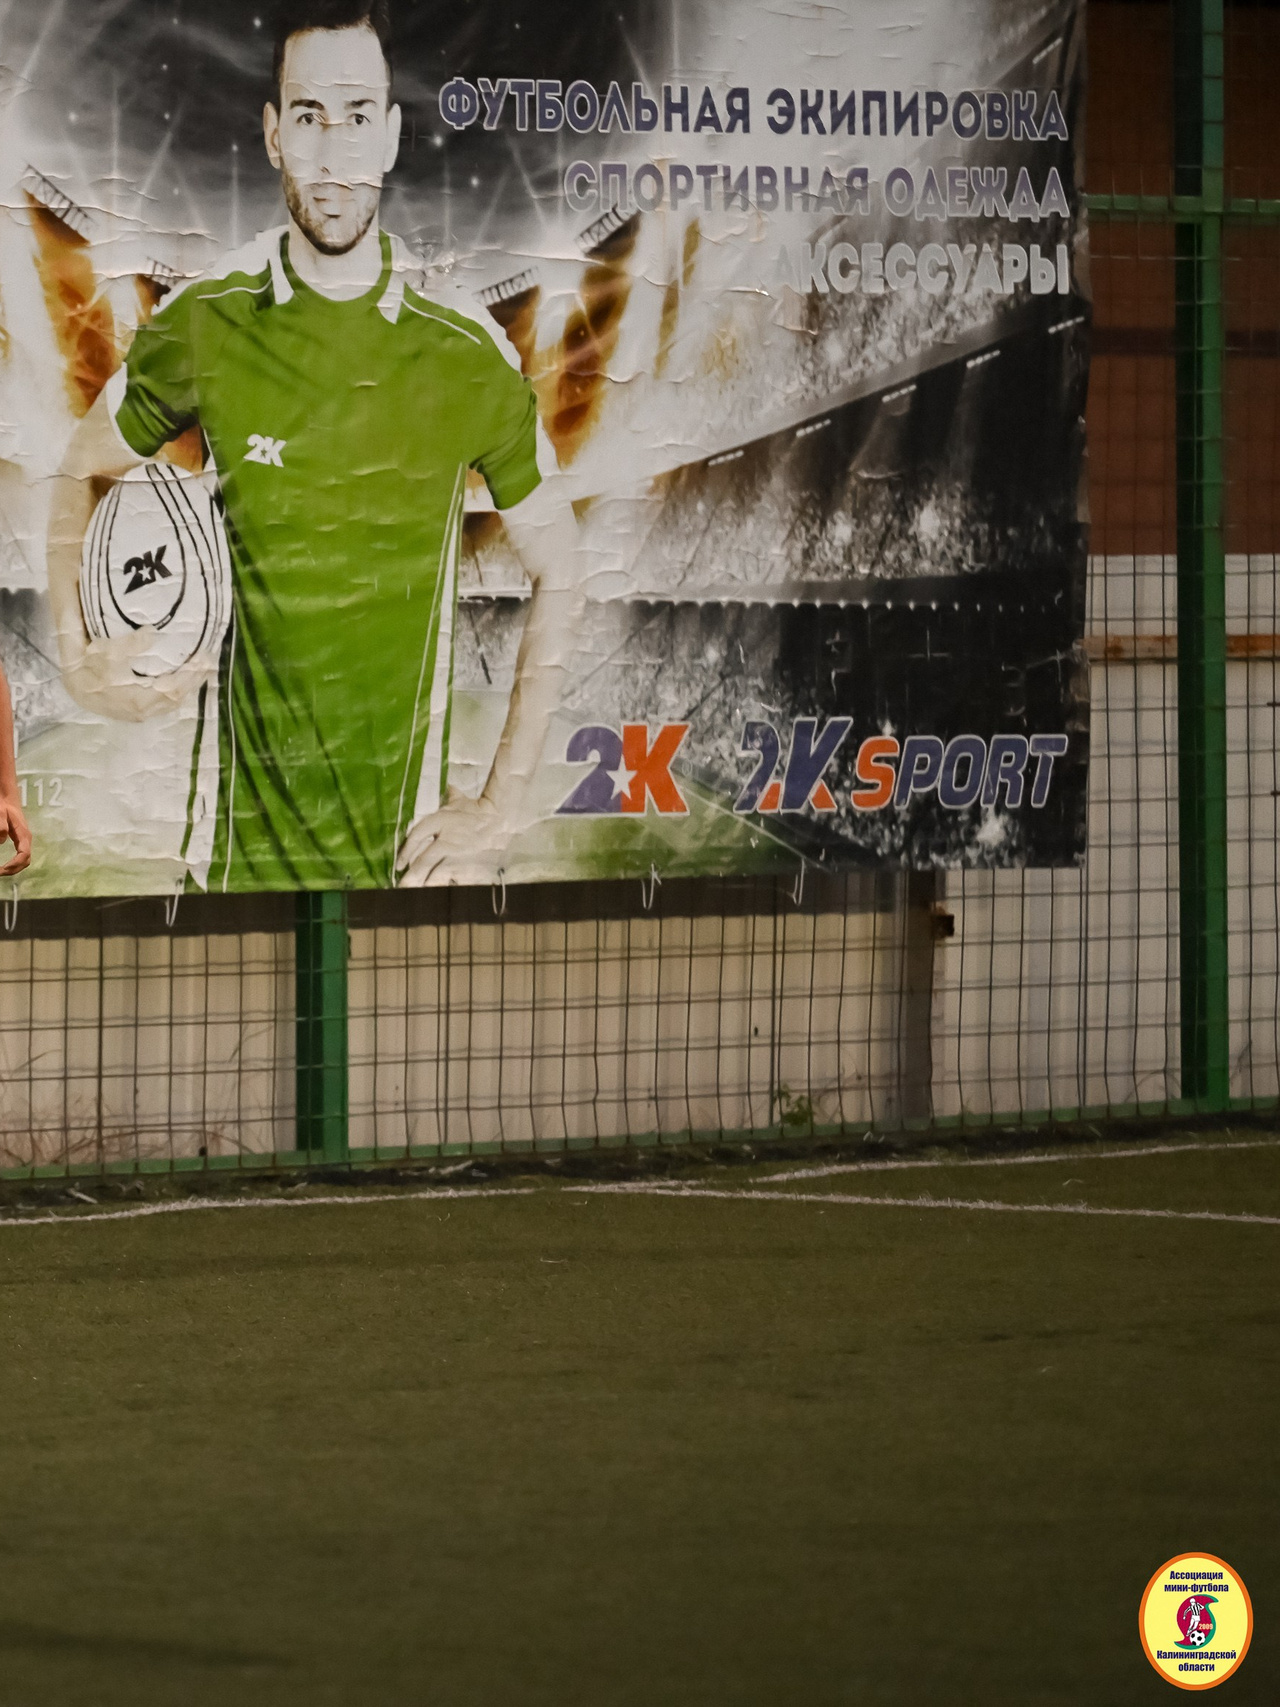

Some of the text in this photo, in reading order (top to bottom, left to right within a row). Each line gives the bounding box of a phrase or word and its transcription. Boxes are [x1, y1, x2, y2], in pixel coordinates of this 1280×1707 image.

[439, 77, 1069, 141] ФУТБОЛЬНАЯ ЭКИПИРОВКА
[564, 160, 1070, 221] СПОРТИВНАЯ ОДЕЖДА
[772, 242, 1070, 295] АКСЕССУАРЫ
[123, 544, 173, 595] 2K
[553, 718, 691, 816] 2K
[850, 734, 1069, 811] SPORT
